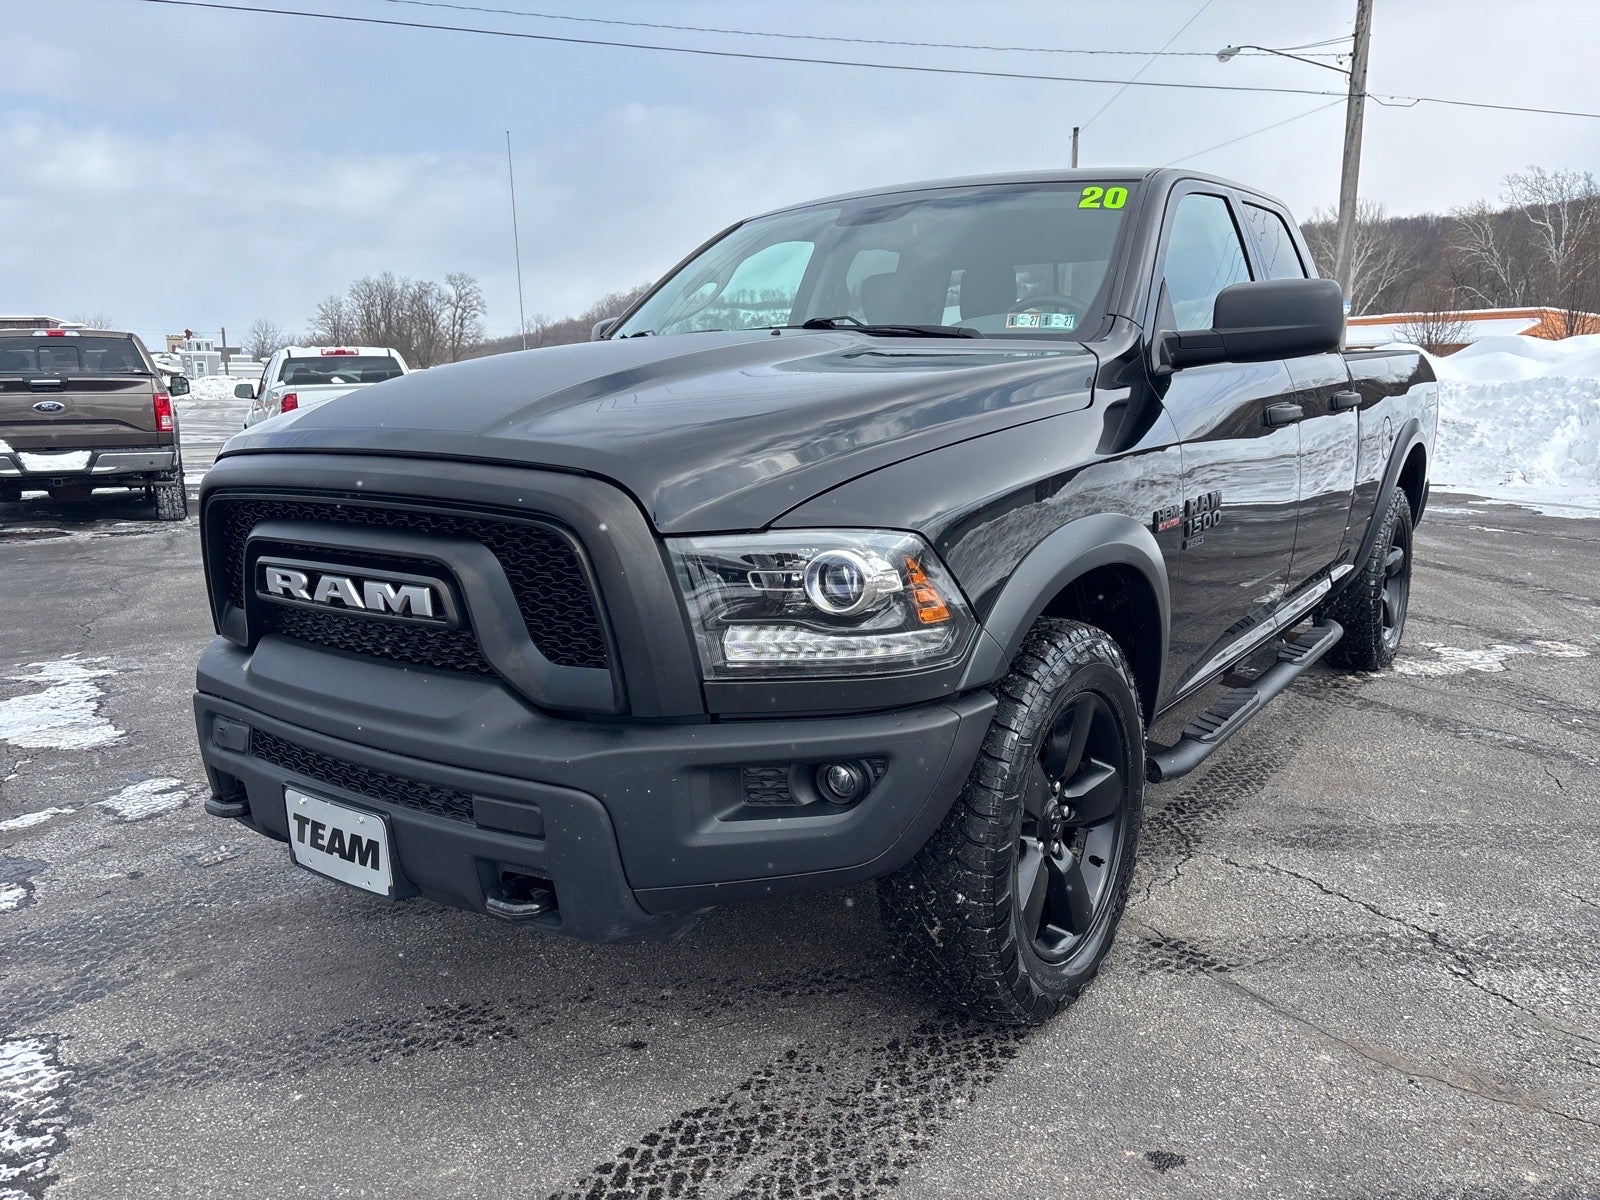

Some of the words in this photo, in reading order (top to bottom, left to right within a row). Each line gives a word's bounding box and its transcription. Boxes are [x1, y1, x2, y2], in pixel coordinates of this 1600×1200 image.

[1079, 186, 1128, 209] 20
[1029, 315, 1038, 326] 27
[1064, 315, 1073, 327] 27
[1156, 504, 1183, 522] HEM
[1186, 490, 1222, 517] RAM
[1186, 509, 1222, 537] 1500
[265, 566, 433, 617] RAM
[293, 812, 380, 871] TEAM
